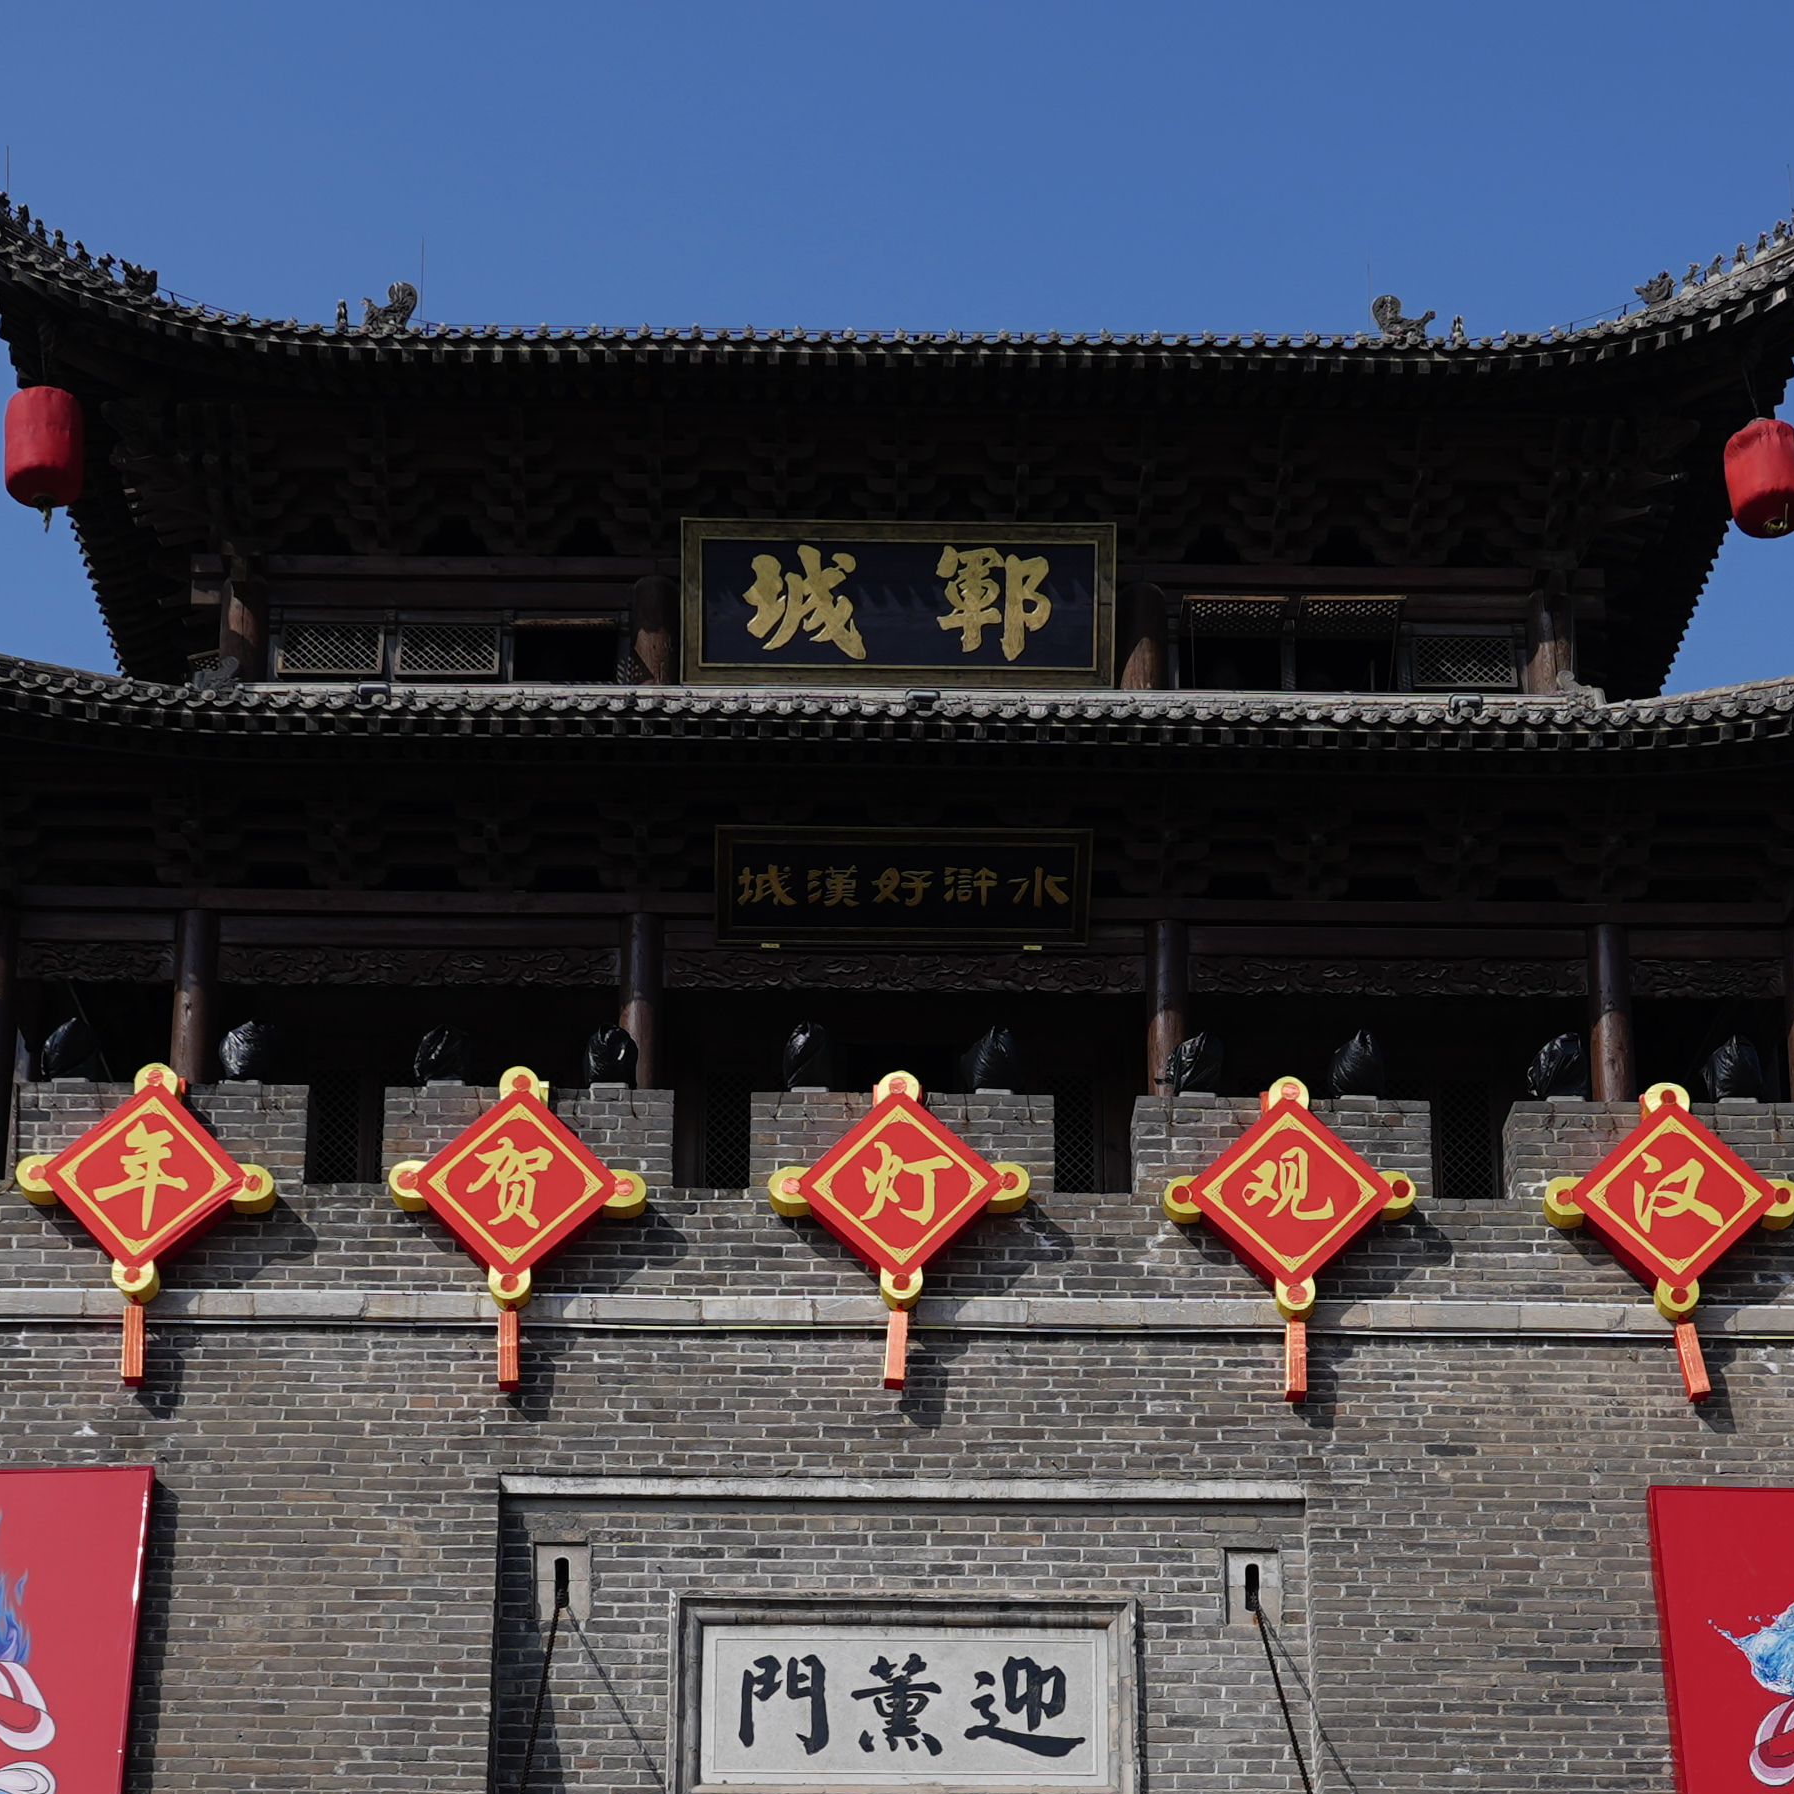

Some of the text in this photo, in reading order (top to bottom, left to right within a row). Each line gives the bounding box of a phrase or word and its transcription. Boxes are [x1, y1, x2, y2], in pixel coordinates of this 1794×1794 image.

[93, 1121, 187, 1231] 年
[467, 1136, 553, 1229] 贺
[860, 1141, 953, 1225] 灯
[1242, 1146, 1335, 1221] 观
[1634, 1152, 1724, 1233] 汉
